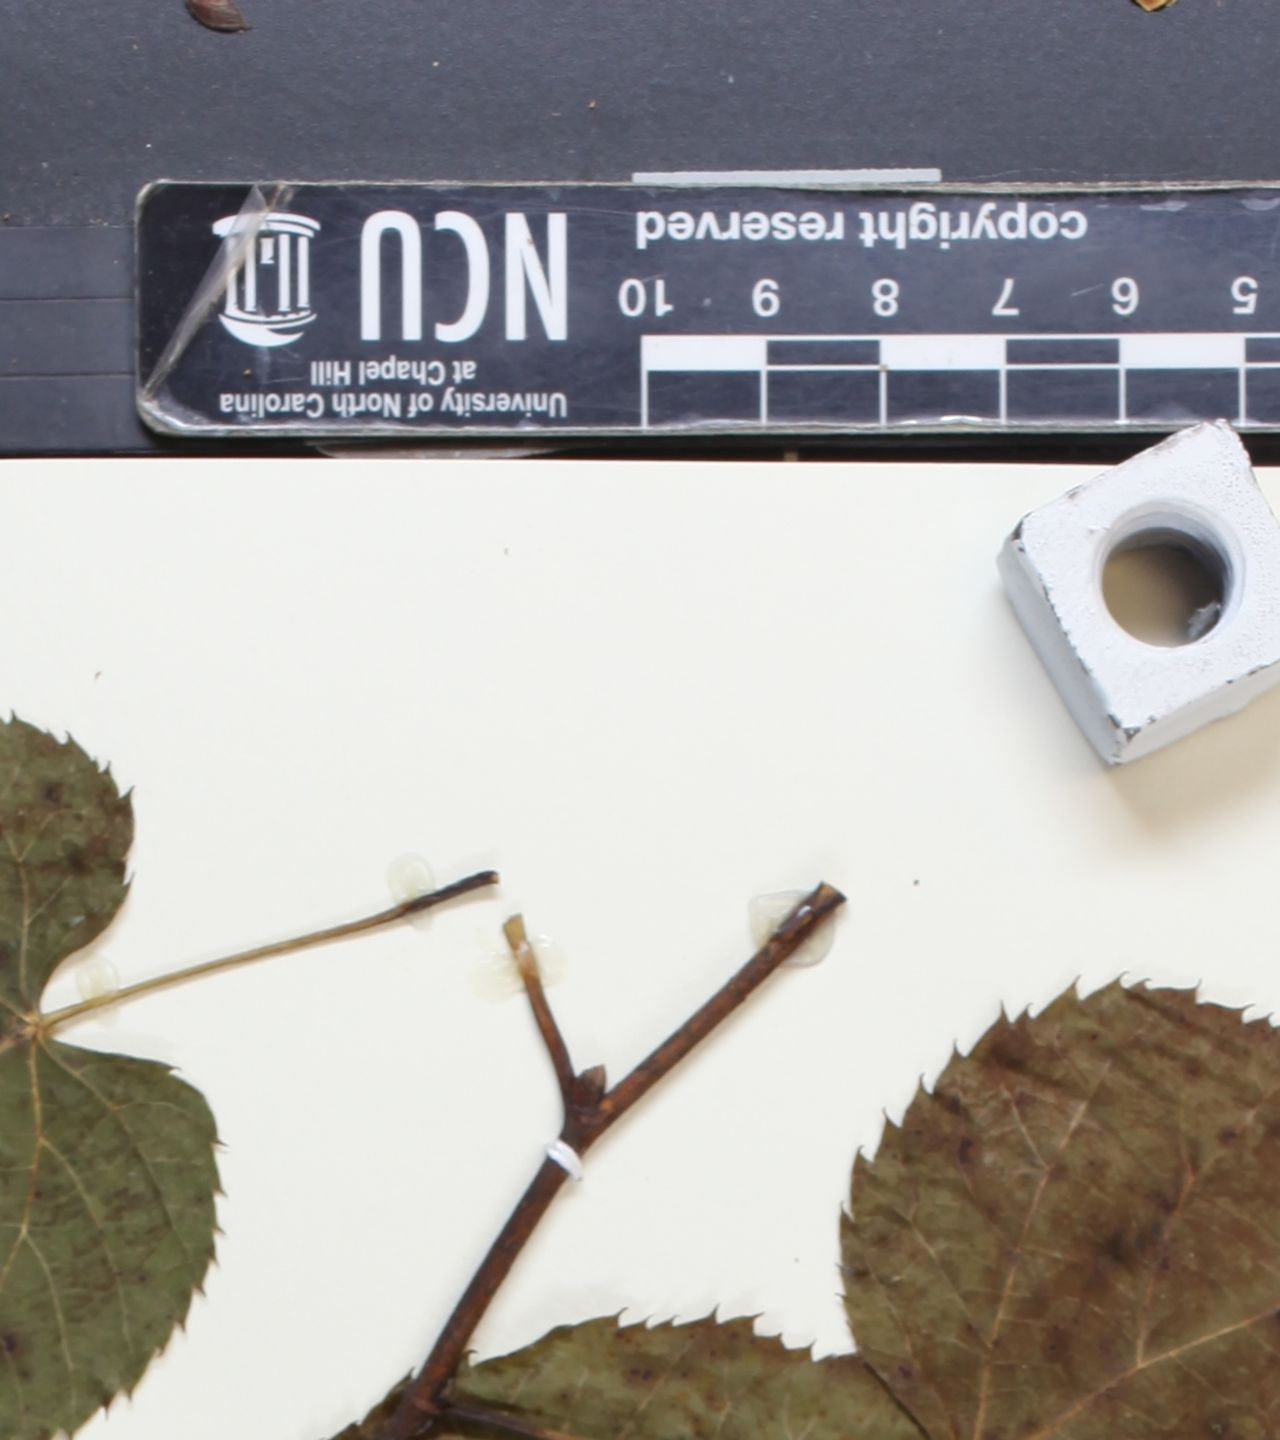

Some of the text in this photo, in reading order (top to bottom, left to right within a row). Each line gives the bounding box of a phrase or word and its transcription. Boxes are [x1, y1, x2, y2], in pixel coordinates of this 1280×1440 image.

[637, 202, 1087, 249] copyright reserved
[361, 210, 567, 343] NCU
[1231, 276, 1258, 314] 5
[618, 278, 673, 317] 10
[752, 279, 780, 317] 9
[872, 278, 899, 317] 8
[992, 278, 1019, 316] 7
[1112, 277, 1139, 315] 6
[312, 358, 476, 385] at Chapel Hill
[221, 391, 566, 418] University of North Carolina
